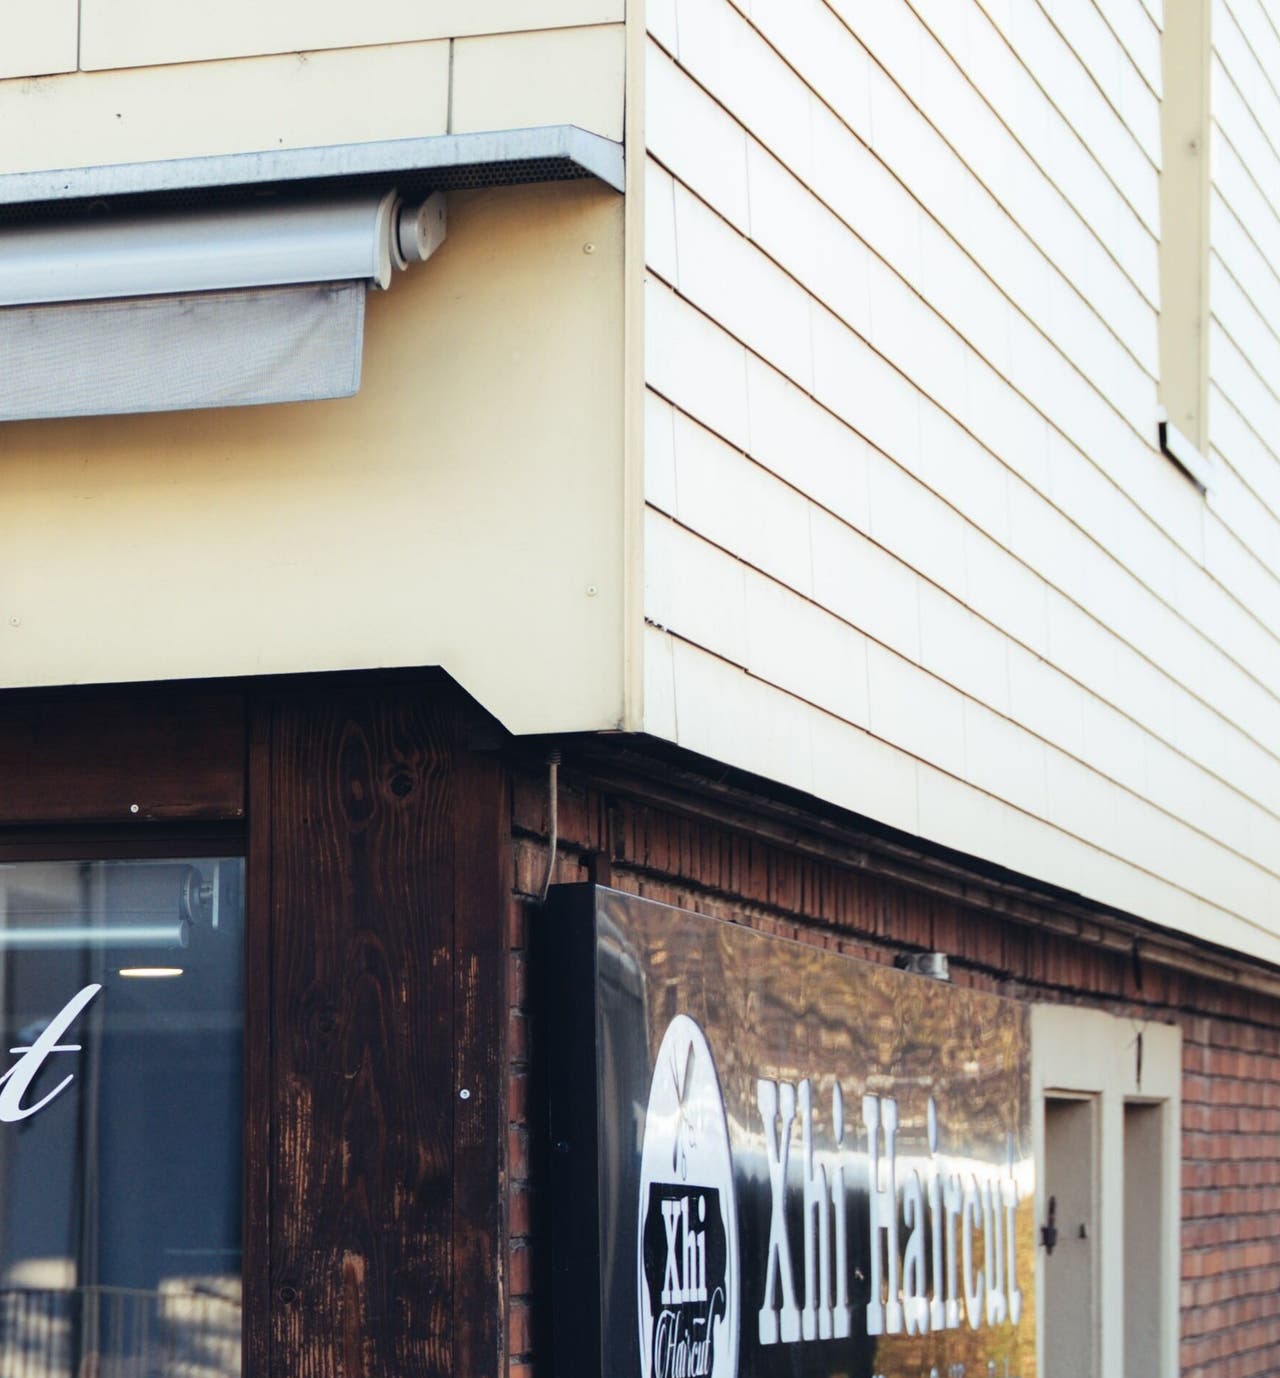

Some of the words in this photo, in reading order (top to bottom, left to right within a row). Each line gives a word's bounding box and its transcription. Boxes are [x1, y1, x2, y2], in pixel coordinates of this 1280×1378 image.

[661, 1195, 708, 1304] Xhi
[757, 1078, 851, 1345] Xhi
[862, 1093, 1020, 1336] Haircut
